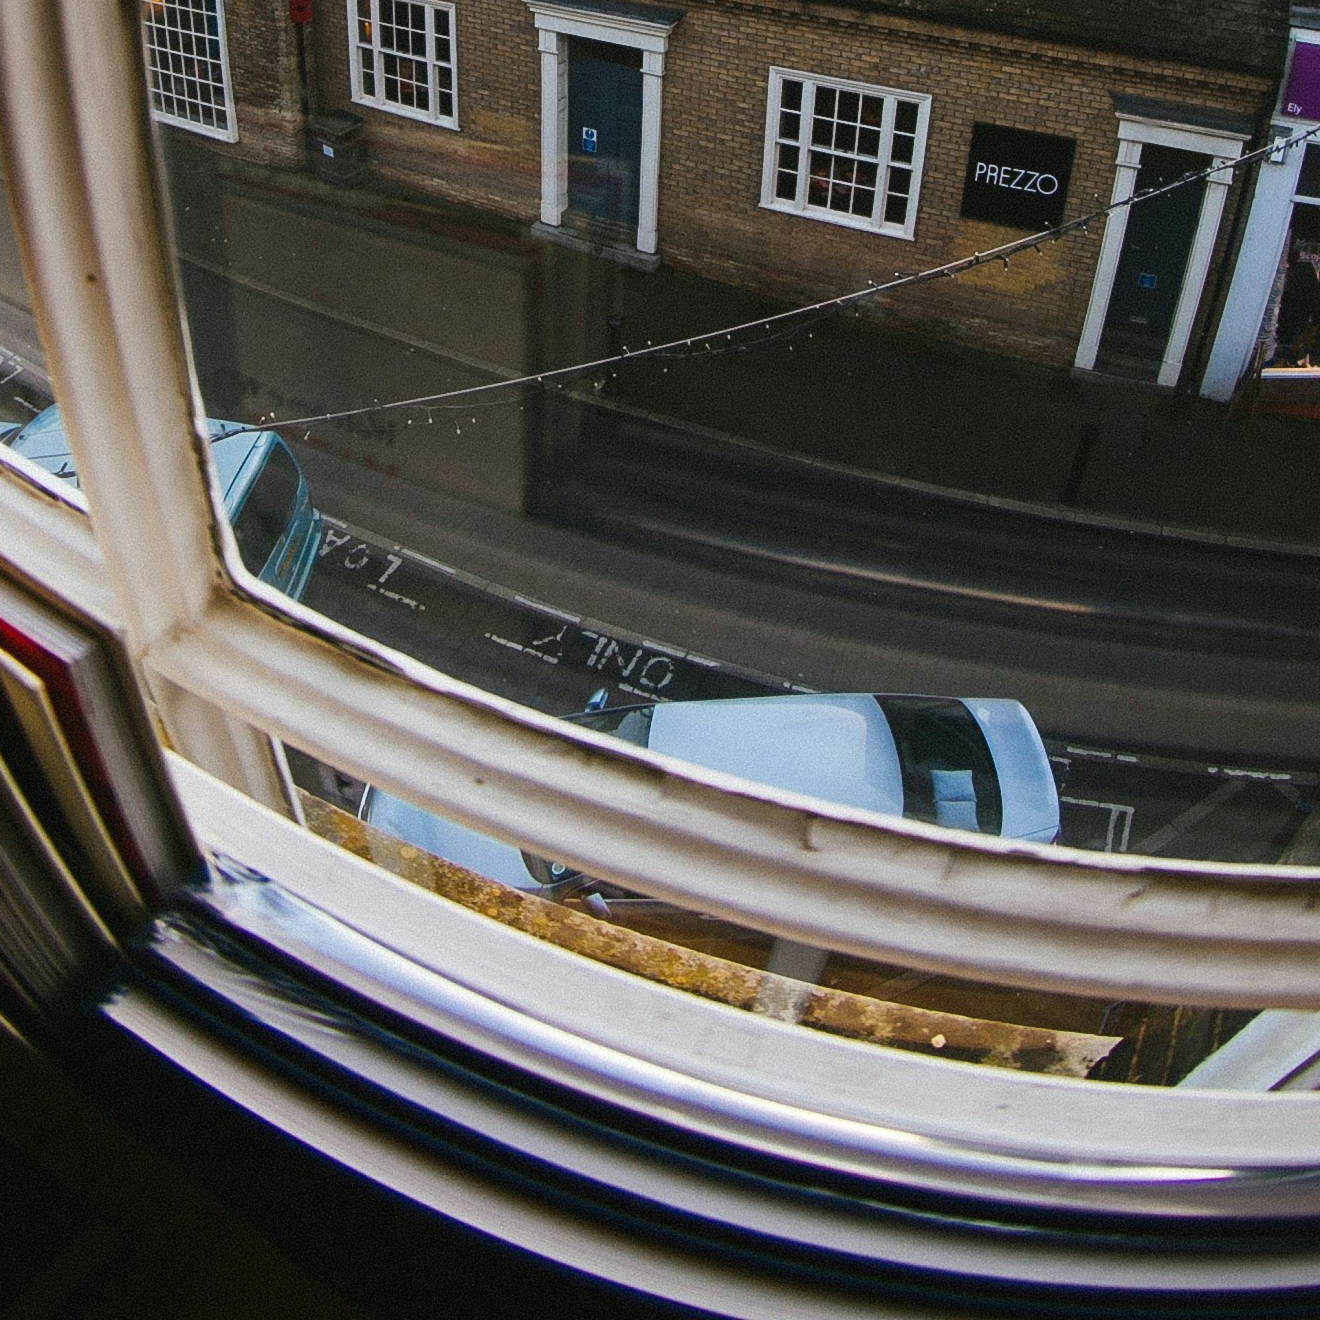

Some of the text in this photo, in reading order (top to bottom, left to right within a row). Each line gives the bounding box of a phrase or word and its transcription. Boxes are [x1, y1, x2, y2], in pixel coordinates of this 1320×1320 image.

[1287, 102, 1302, 116] Ely
[974, 161, 1059, 195] PREZZO
[532, 625, 676, 691] ONLY
